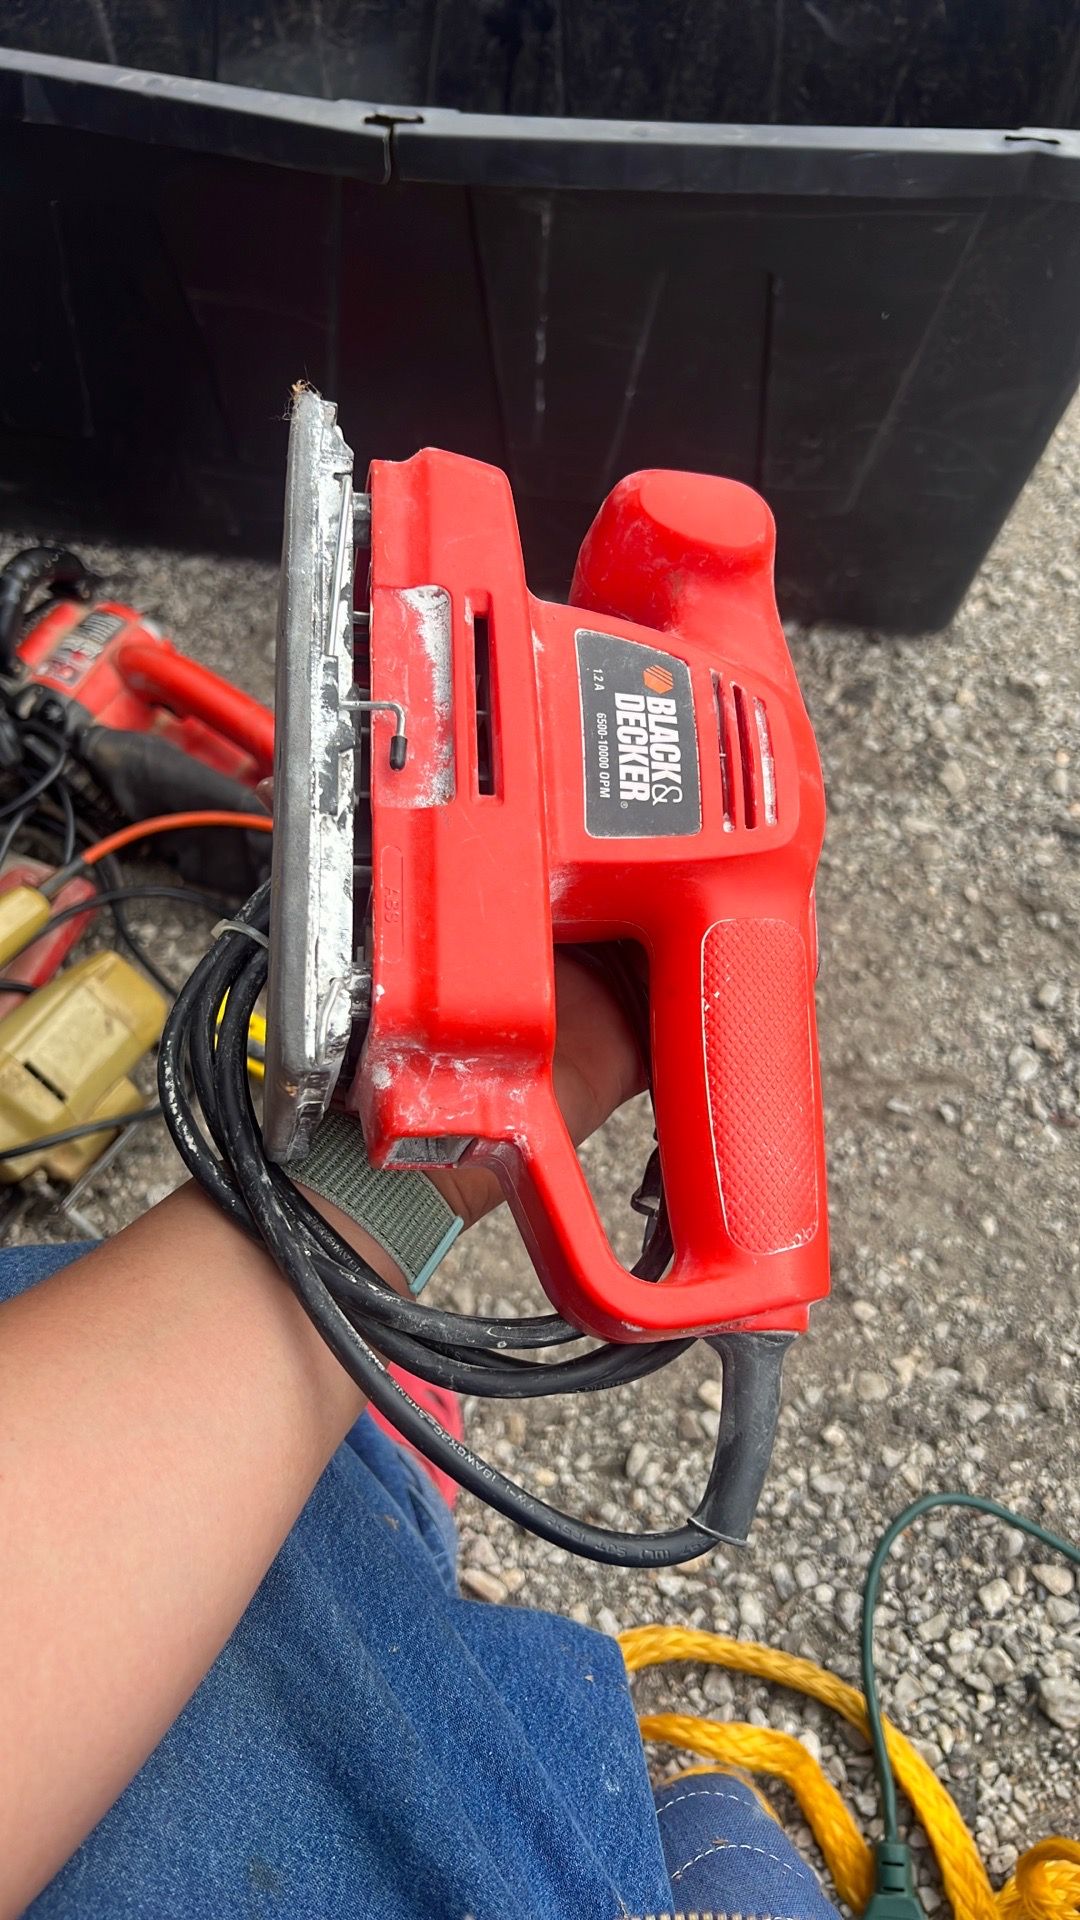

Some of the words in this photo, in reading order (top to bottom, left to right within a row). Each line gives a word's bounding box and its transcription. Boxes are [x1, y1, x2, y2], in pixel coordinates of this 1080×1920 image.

[593, 668, 604, 684] 1.2
[596, 713, 609, 768] 6500-10000
[599, 773, 610, 799] OPM
